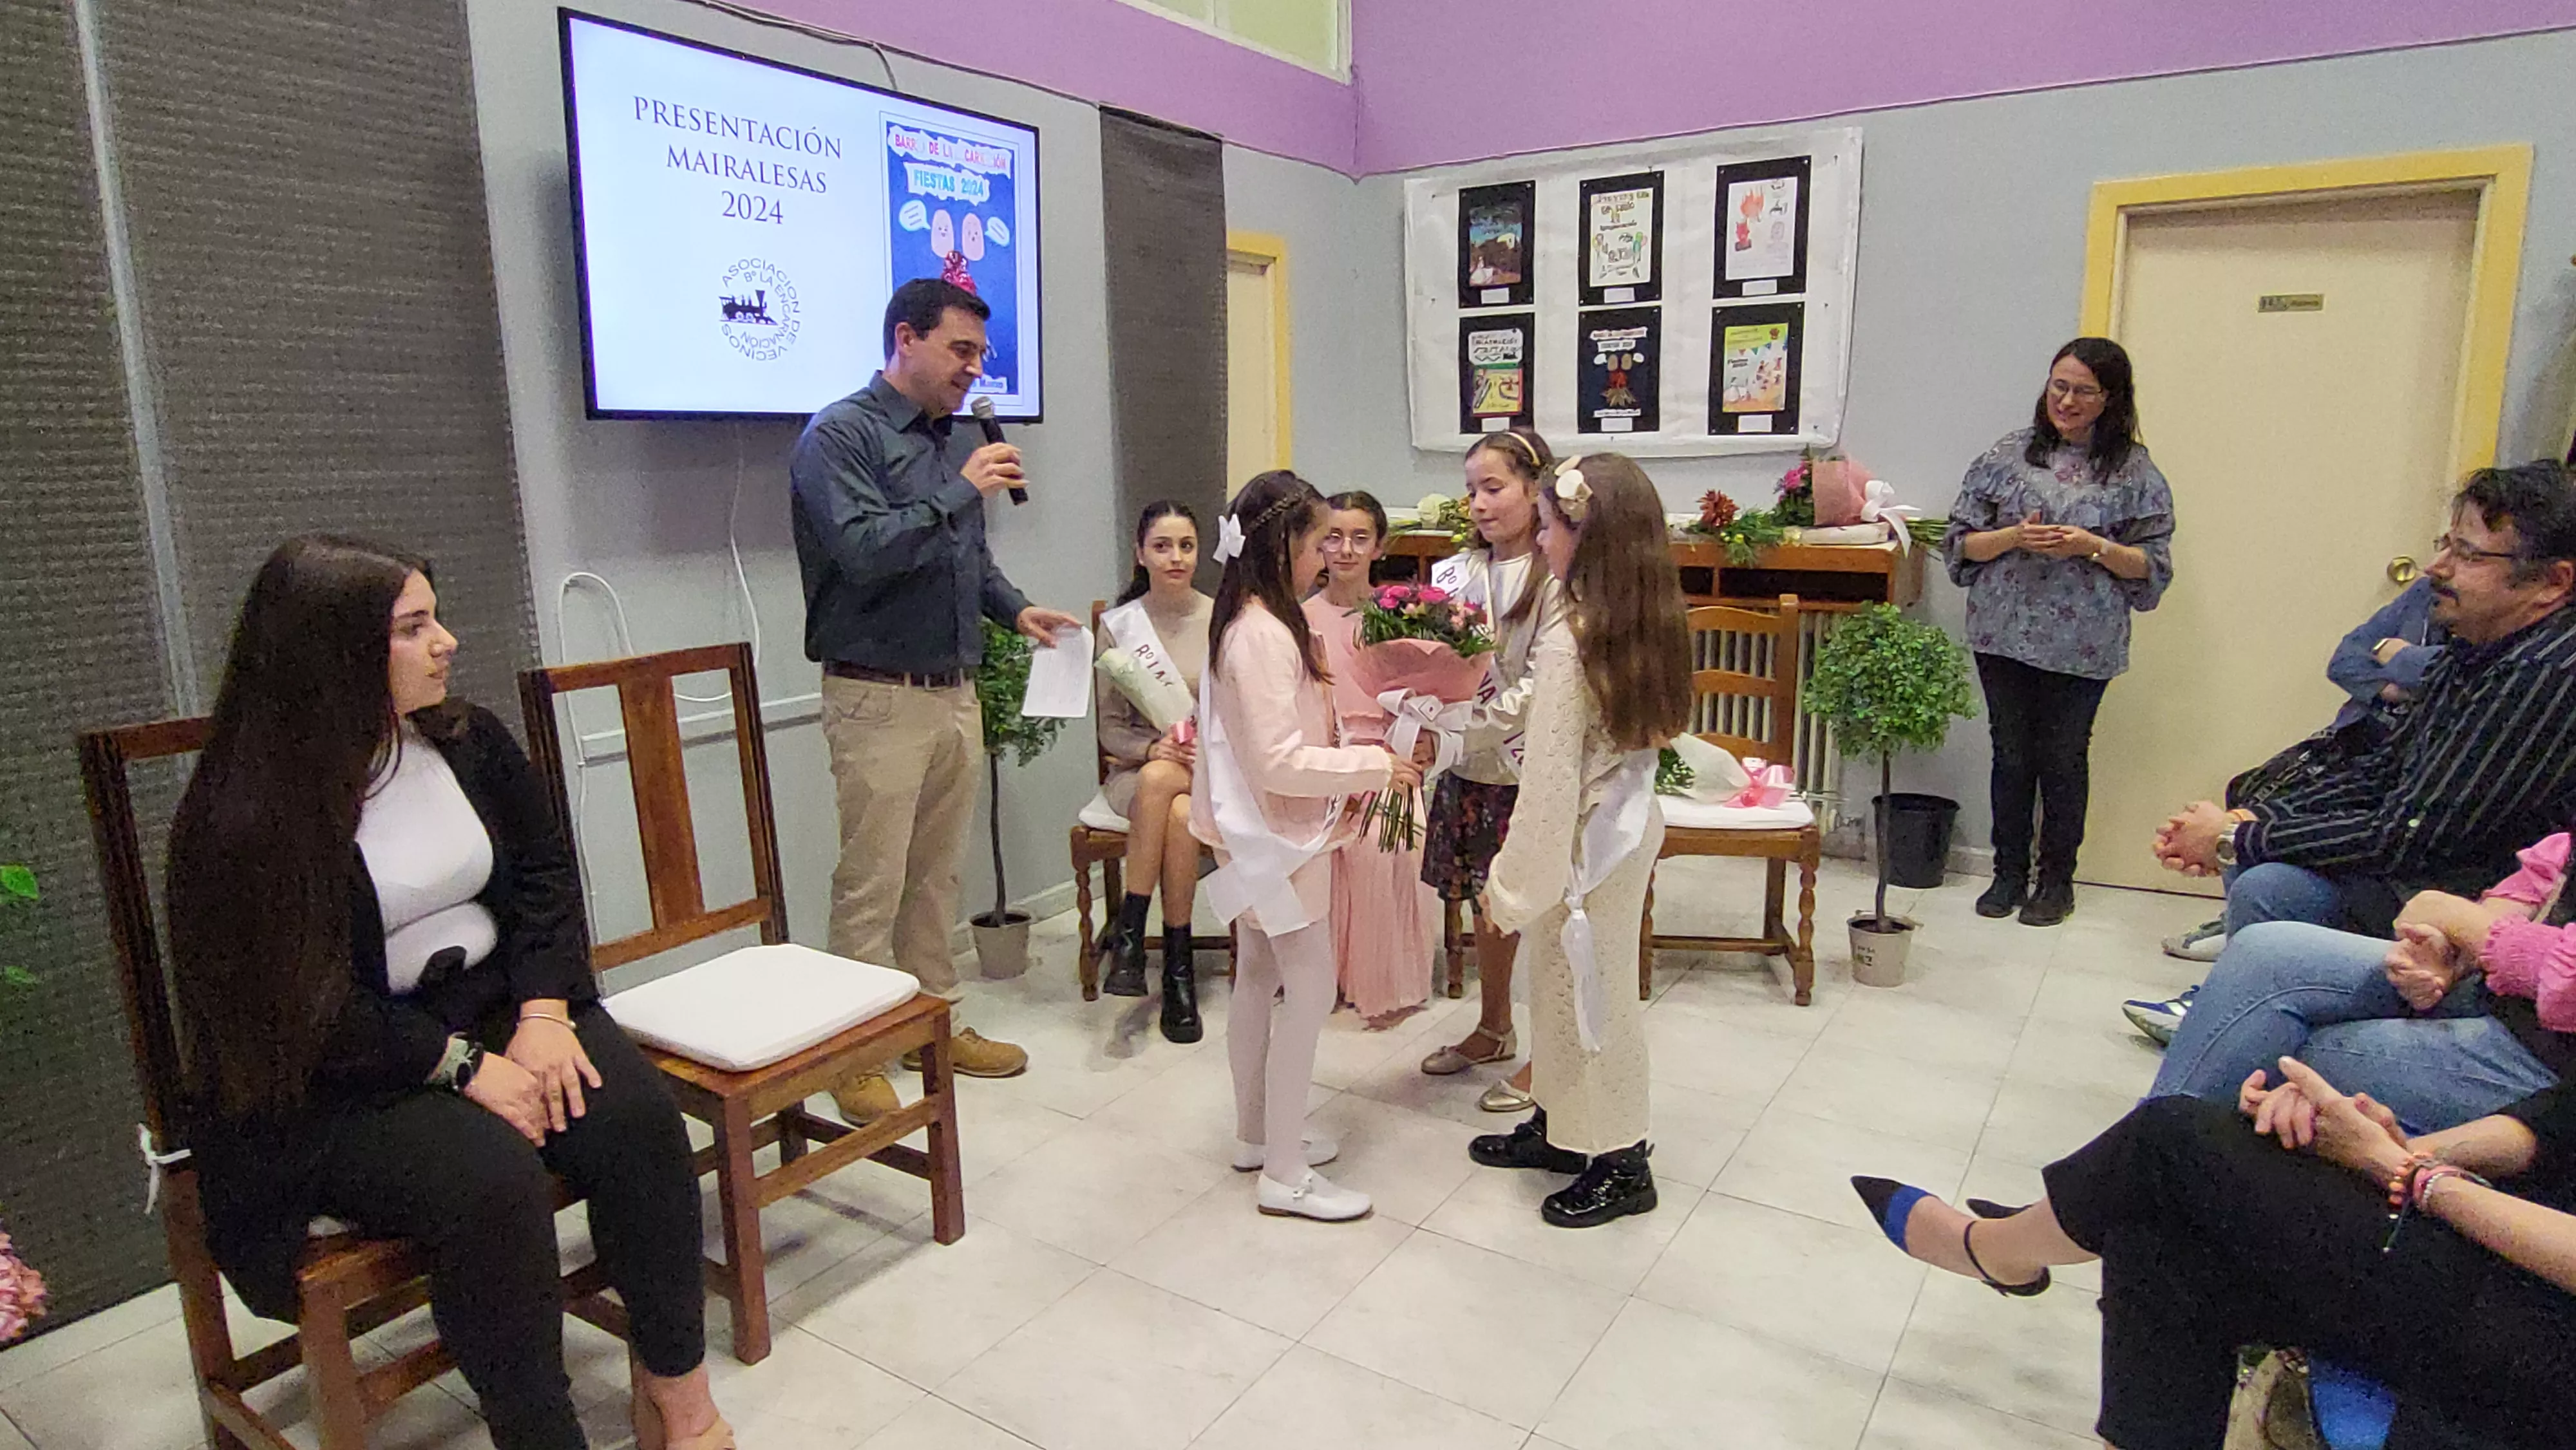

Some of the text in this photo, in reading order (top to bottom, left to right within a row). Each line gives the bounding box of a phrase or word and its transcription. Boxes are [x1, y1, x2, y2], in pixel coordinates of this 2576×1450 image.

[634, 95, 841, 159] PRESENTACIÓN
[929, 142, 940, 155] DE
[667, 144, 826, 193] MAIRALESAS
[914, 169, 955, 193] FIESTAS
[721, 191, 784, 224] 2024
[760, 271, 773, 287] LA
[721, 258, 800, 361] ASOCIACION DE VECINOS
